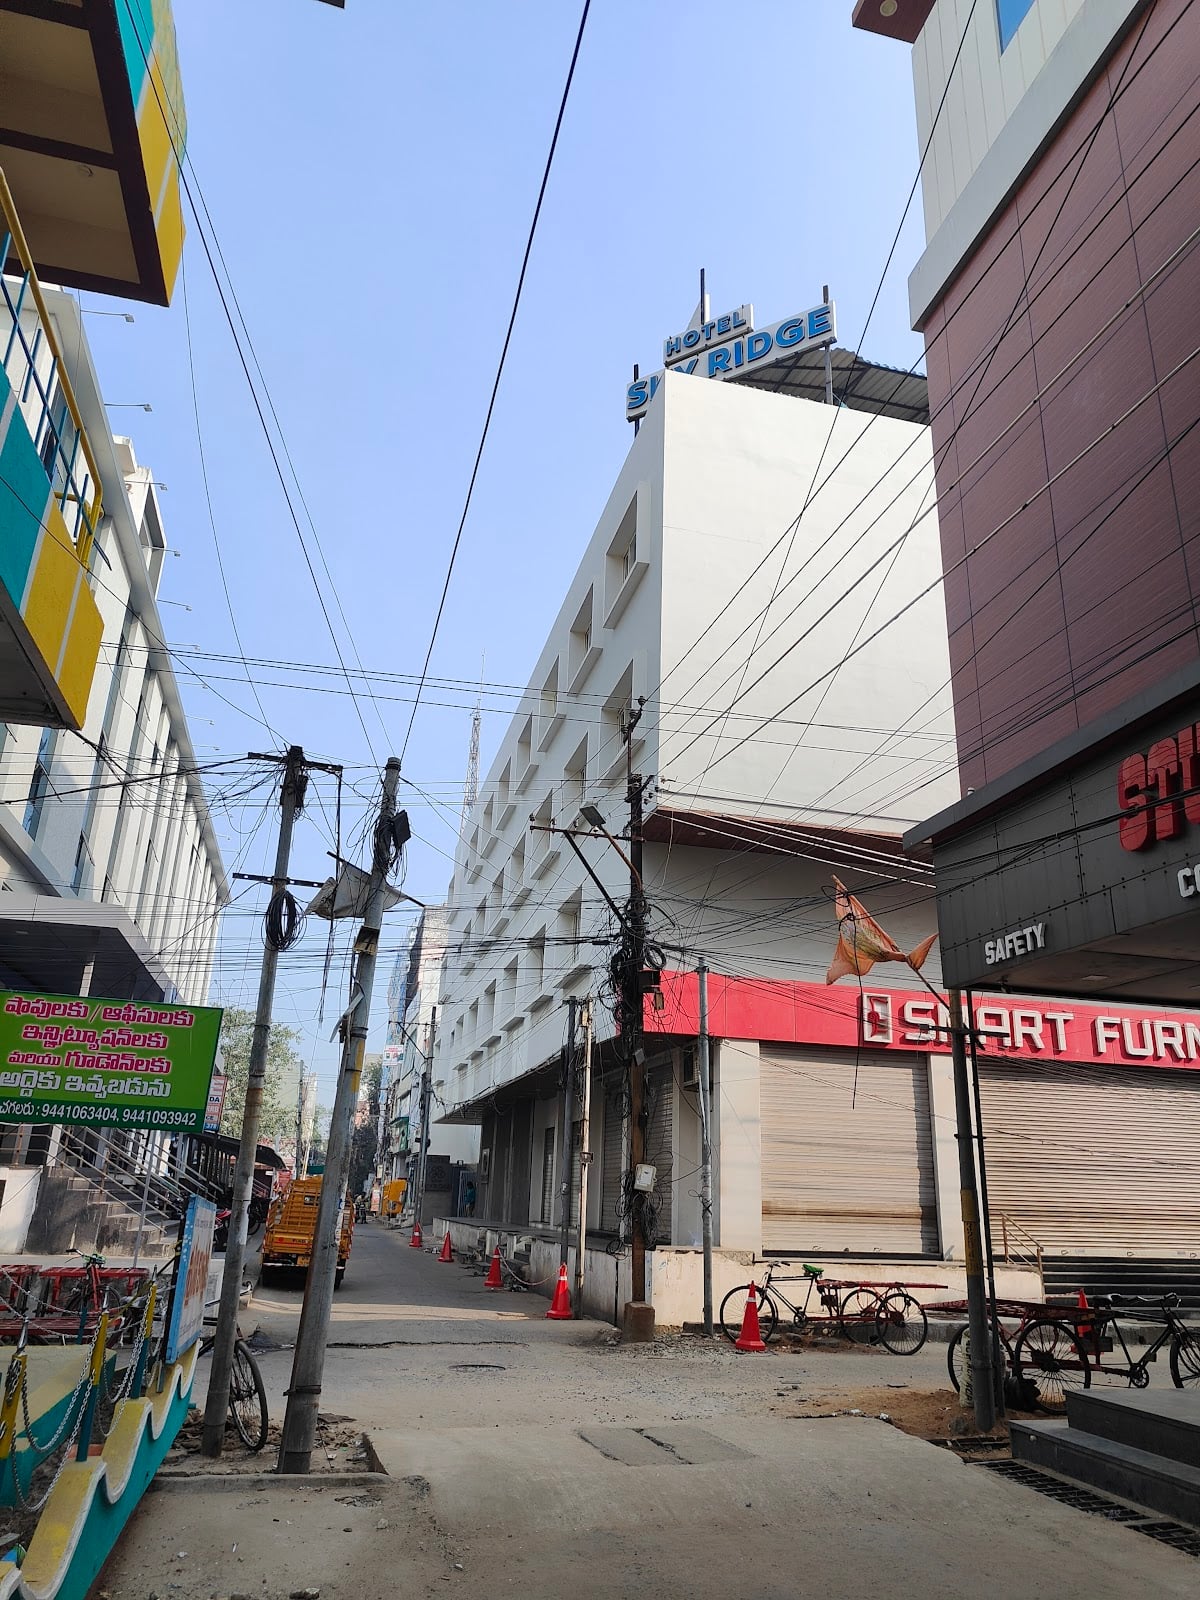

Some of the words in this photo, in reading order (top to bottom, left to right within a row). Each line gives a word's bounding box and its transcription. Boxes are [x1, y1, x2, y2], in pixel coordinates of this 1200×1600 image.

[666, 311, 746, 357] HOTEL
[708, 305, 832, 378] RIDGE
[985, 922, 1045, 965] SAFETY
[904, 1001, 1073, 1050] SMART
[122, 1109, 197, 1126] 9441093942
